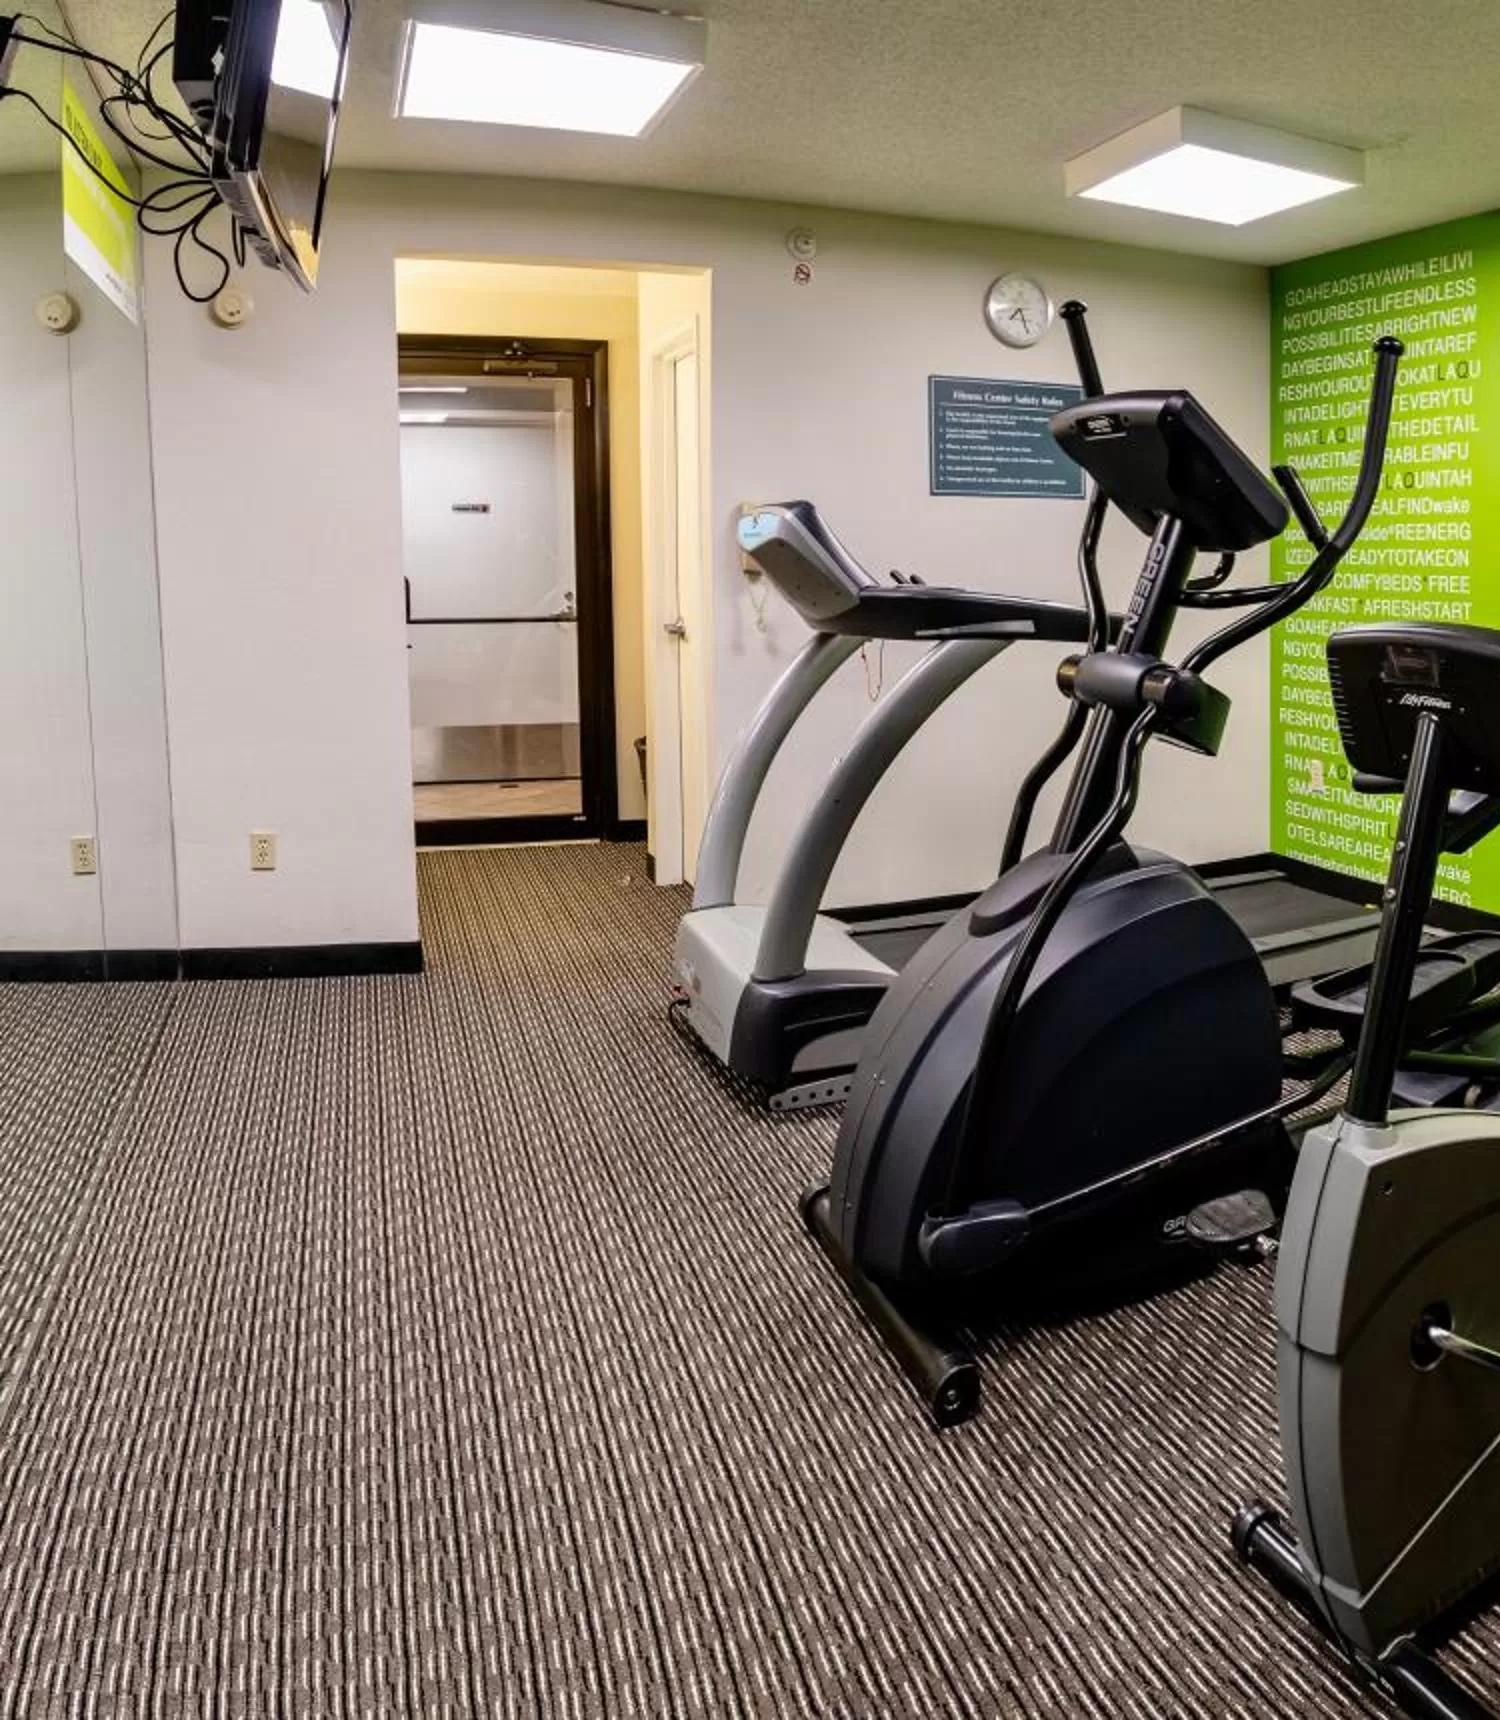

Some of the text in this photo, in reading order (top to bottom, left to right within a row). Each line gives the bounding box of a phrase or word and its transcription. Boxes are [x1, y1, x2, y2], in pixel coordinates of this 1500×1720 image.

[1283, 278, 1476, 332] NGYOURBESTLIFEENDLESS
[953, 390, 1063, 406] Fitness Center Safety Rules
[1122, 543, 1166, 634] GREEN
